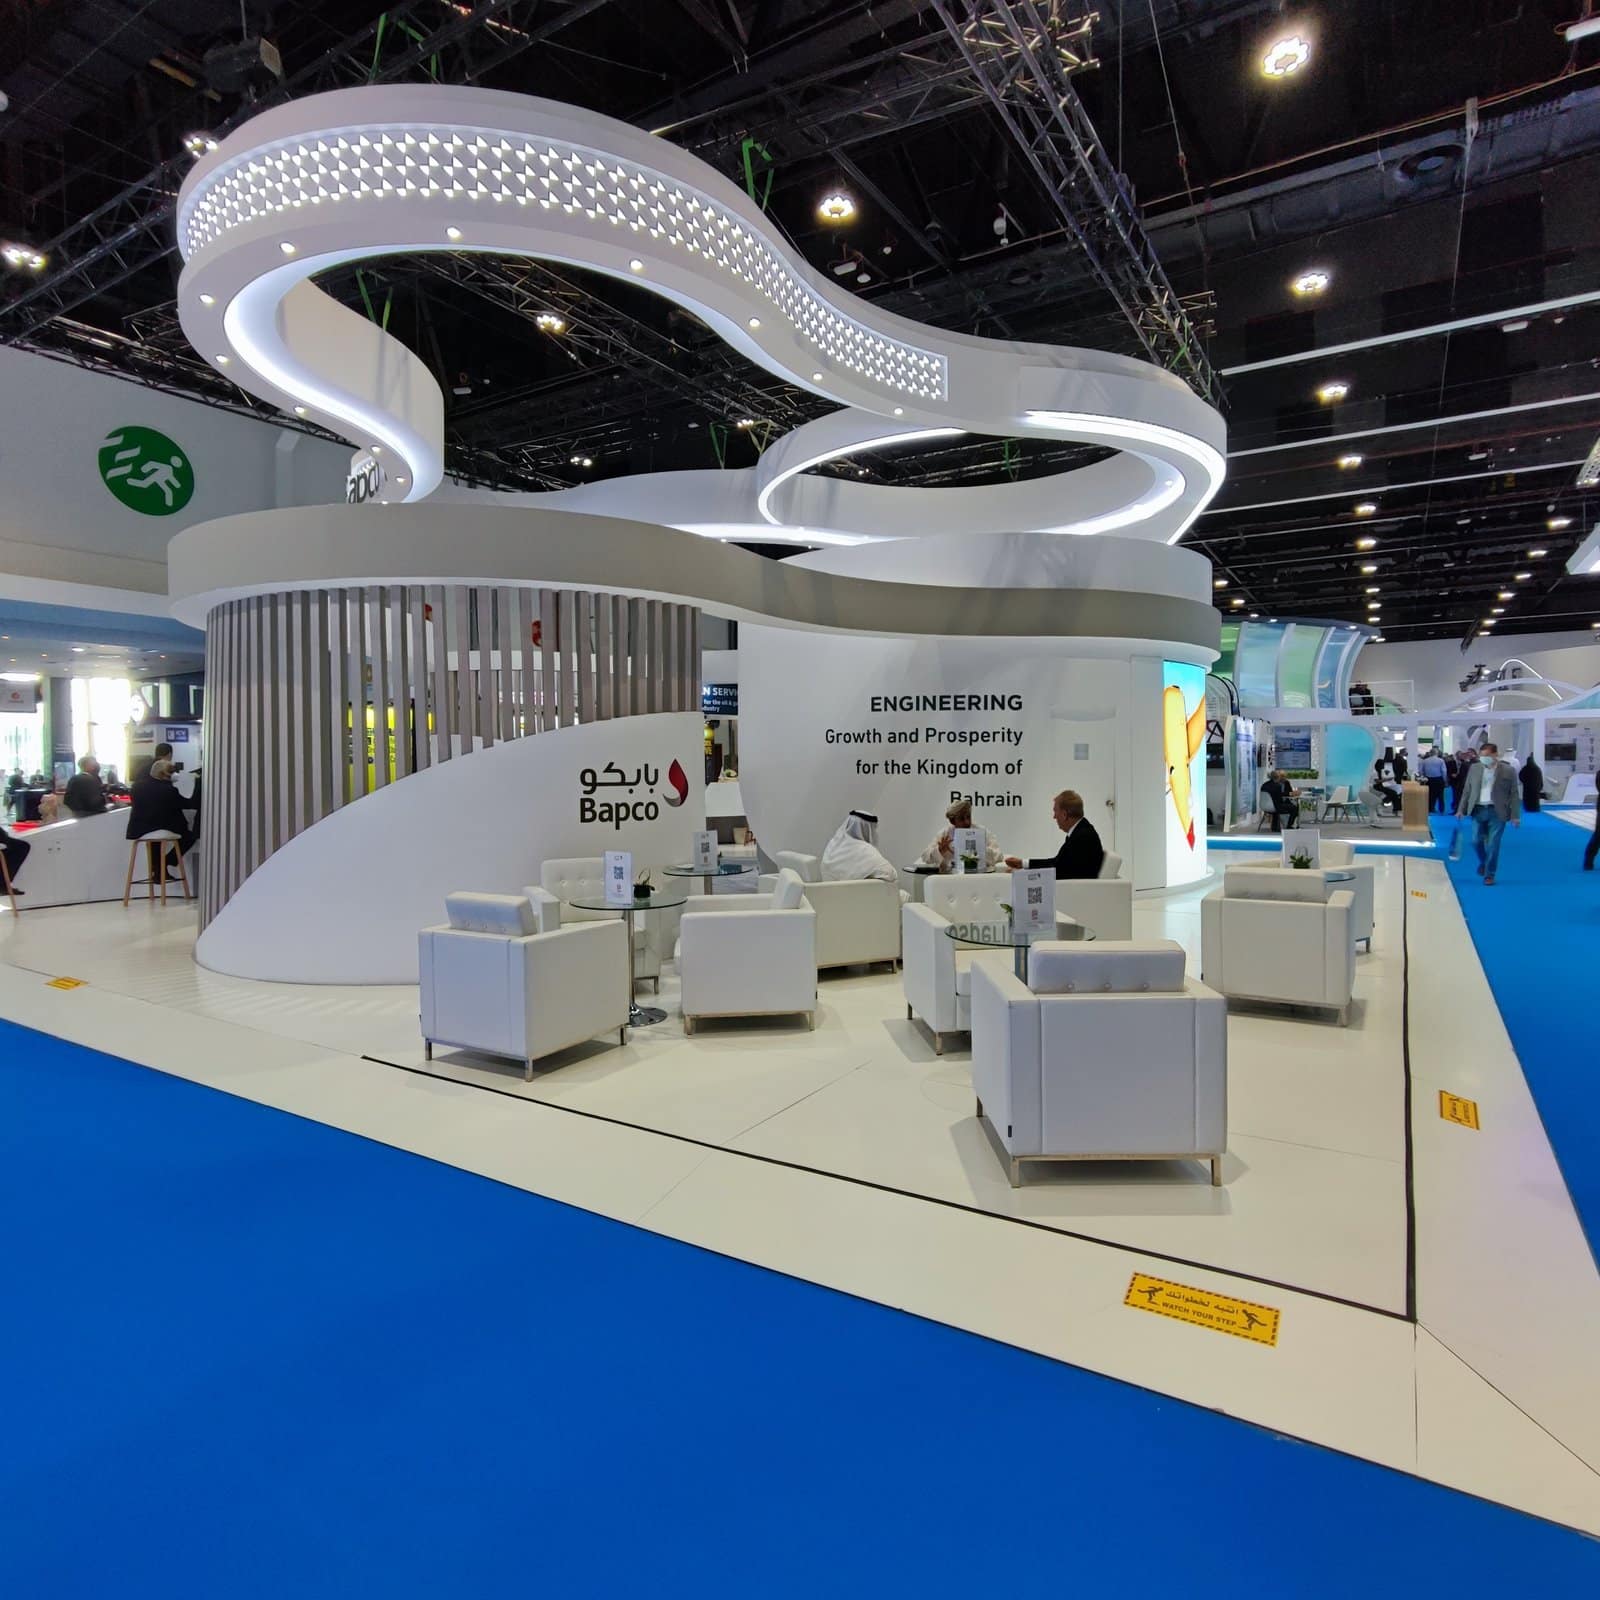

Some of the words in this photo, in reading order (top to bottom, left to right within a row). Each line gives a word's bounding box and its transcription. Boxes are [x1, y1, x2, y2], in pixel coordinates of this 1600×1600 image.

[871, 694, 1023, 712] ENGINEERING
[825, 728, 882, 744] Growth
[887, 728, 919, 744] and
[925, 727, 1023, 746] Prosperity
[856, 760, 879, 775] for
[884, 760, 911, 775] the
[917, 759, 999, 778] Kingdom
[1005, 759, 1023, 775] of
[580, 762, 659, 795] بابكو
[950, 791, 1023, 807] Bahrain
[580, 798, 659, 830] Bapco
[1162, 1302, 1190, 1313] WATCH
[1192, 1310, 1214, 1321] YOUR
[1215, 1316, 1237, 1326] STEP
